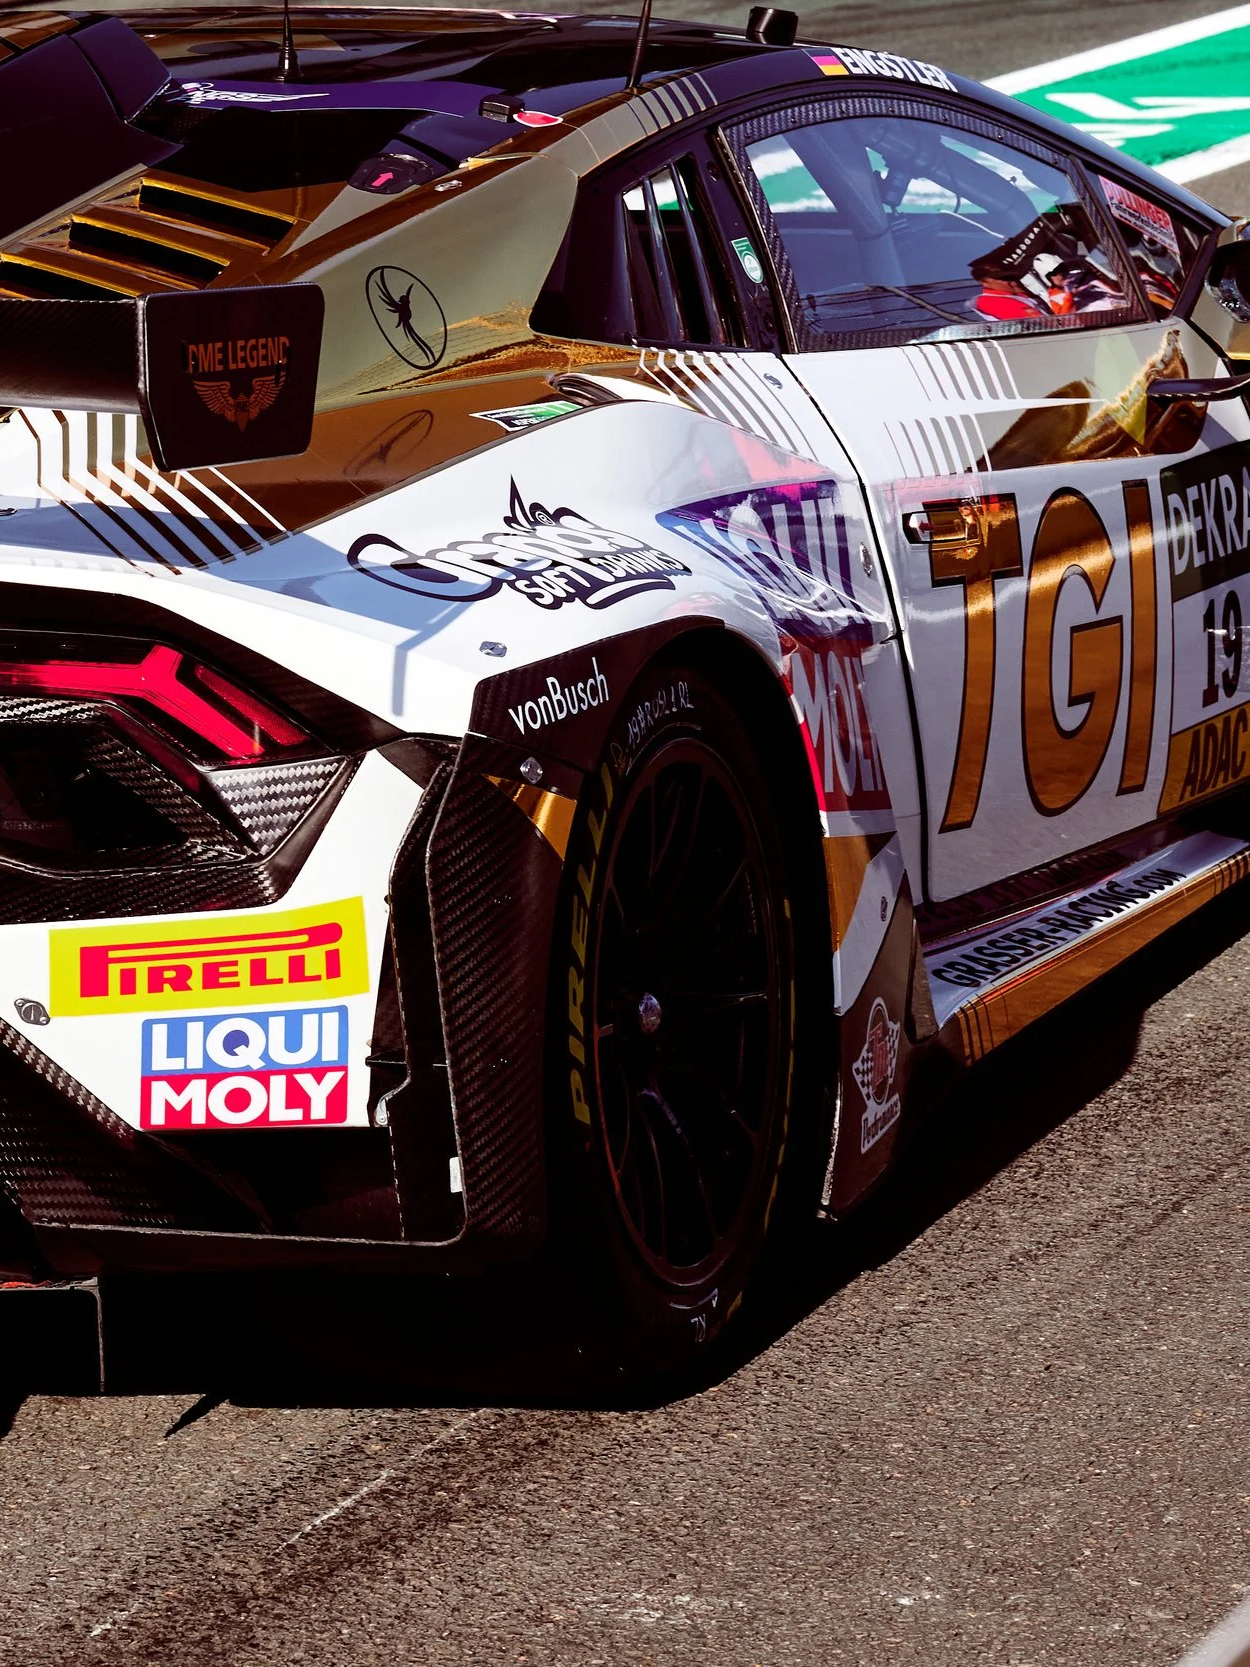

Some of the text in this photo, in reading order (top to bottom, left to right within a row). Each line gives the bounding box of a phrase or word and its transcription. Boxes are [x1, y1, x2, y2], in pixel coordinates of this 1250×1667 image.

[830, 47, 958, 93] ENGSTLER
[228, 336, 290, 370] LEGEND
[515, 549, 685, 605] SOFT DRINKS
[922, 478, 1158, 834] TGI
[1203, 590, 1242, 708] 19
[508, 656, 610, 735] vonBusch
[1178, 708, 1248, 802] ADAC
[80, 922, 343, 998] PIRELLI
[568, 762, 614, 1125] PIRELLI
[931, 867, 1188, 988] GRASSER-RACING.COM
[151, 1011, 340, 1071] LIQUI
[151, 1070, 345, 1126] MOLY
